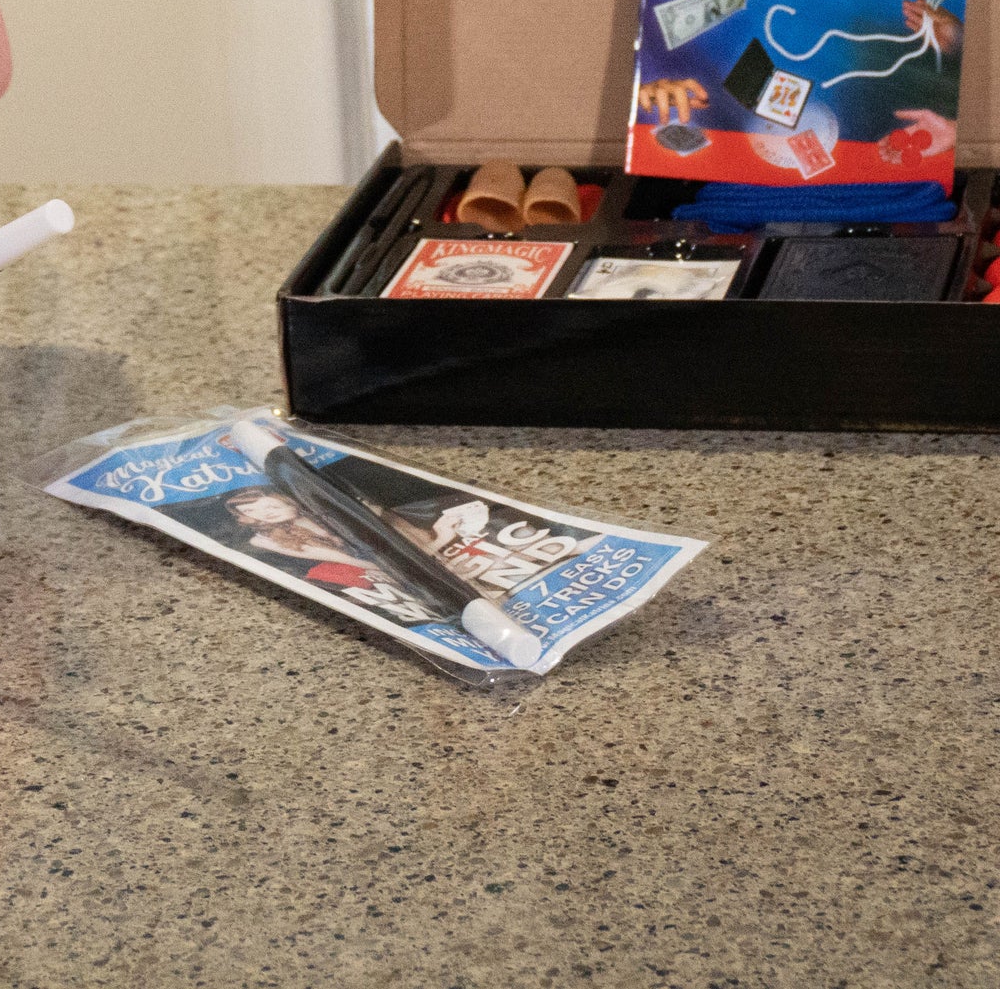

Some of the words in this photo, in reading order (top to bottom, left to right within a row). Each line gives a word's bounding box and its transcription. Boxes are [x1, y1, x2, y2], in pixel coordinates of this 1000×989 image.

[431, 241, 550, 263] KINGMAGIC
[529, 580, 549, 597] 7
[560, 544, 614, 580] EASY
[536, 547, 636, 610] TRICKS
[547, 591, 608, 625] CAN
[602, 556, 653, 591] DO!
